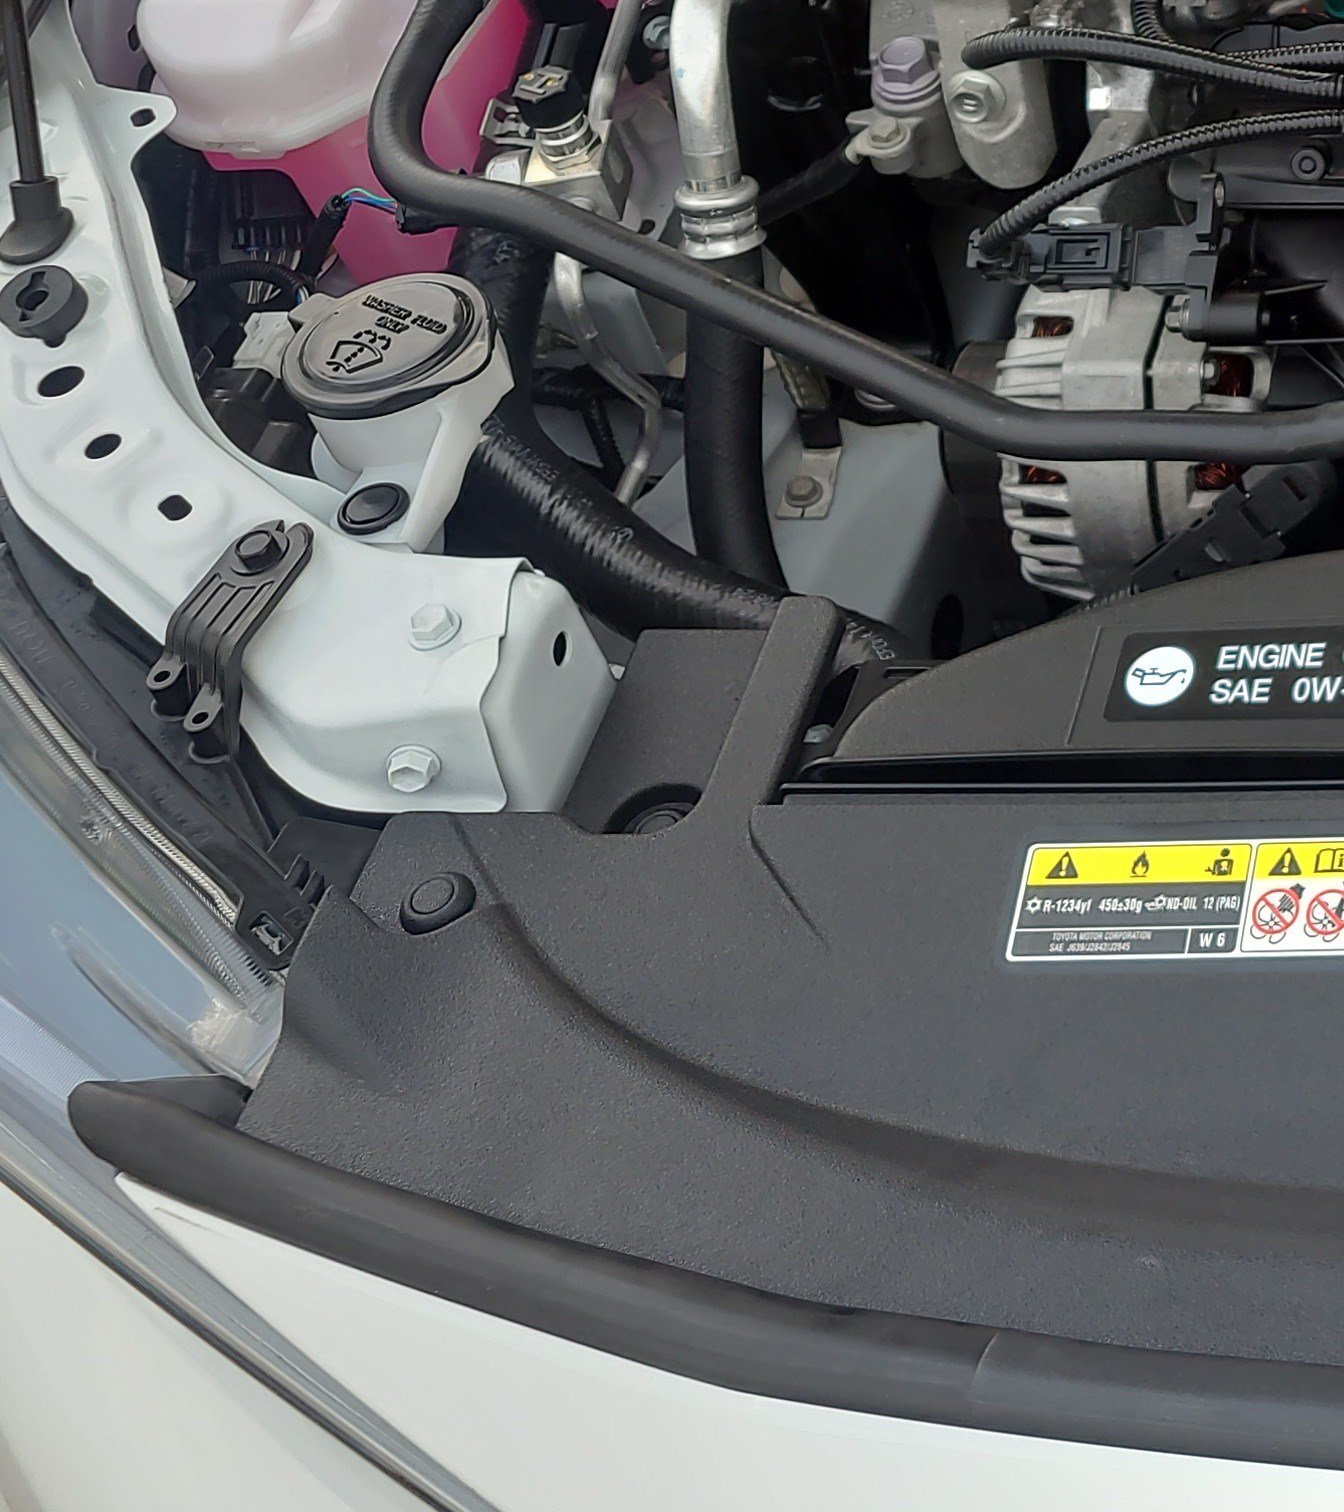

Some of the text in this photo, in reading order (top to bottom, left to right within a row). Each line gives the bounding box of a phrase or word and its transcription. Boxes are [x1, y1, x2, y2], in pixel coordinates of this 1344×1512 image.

[1215, 642, 1326, 670] ENGINE
[1209, 677, 1273, 704] SAE
[1042, 895, 1241, 916] R-1234yf 450±30g ND-OIL 12 (PAG)
[1051, 931, 1153, 941] TOYOTA MOTOR CORPORATION
[1199, 932, 1226, 948] W 6
[1048, 943, 1064, 952] SAE
